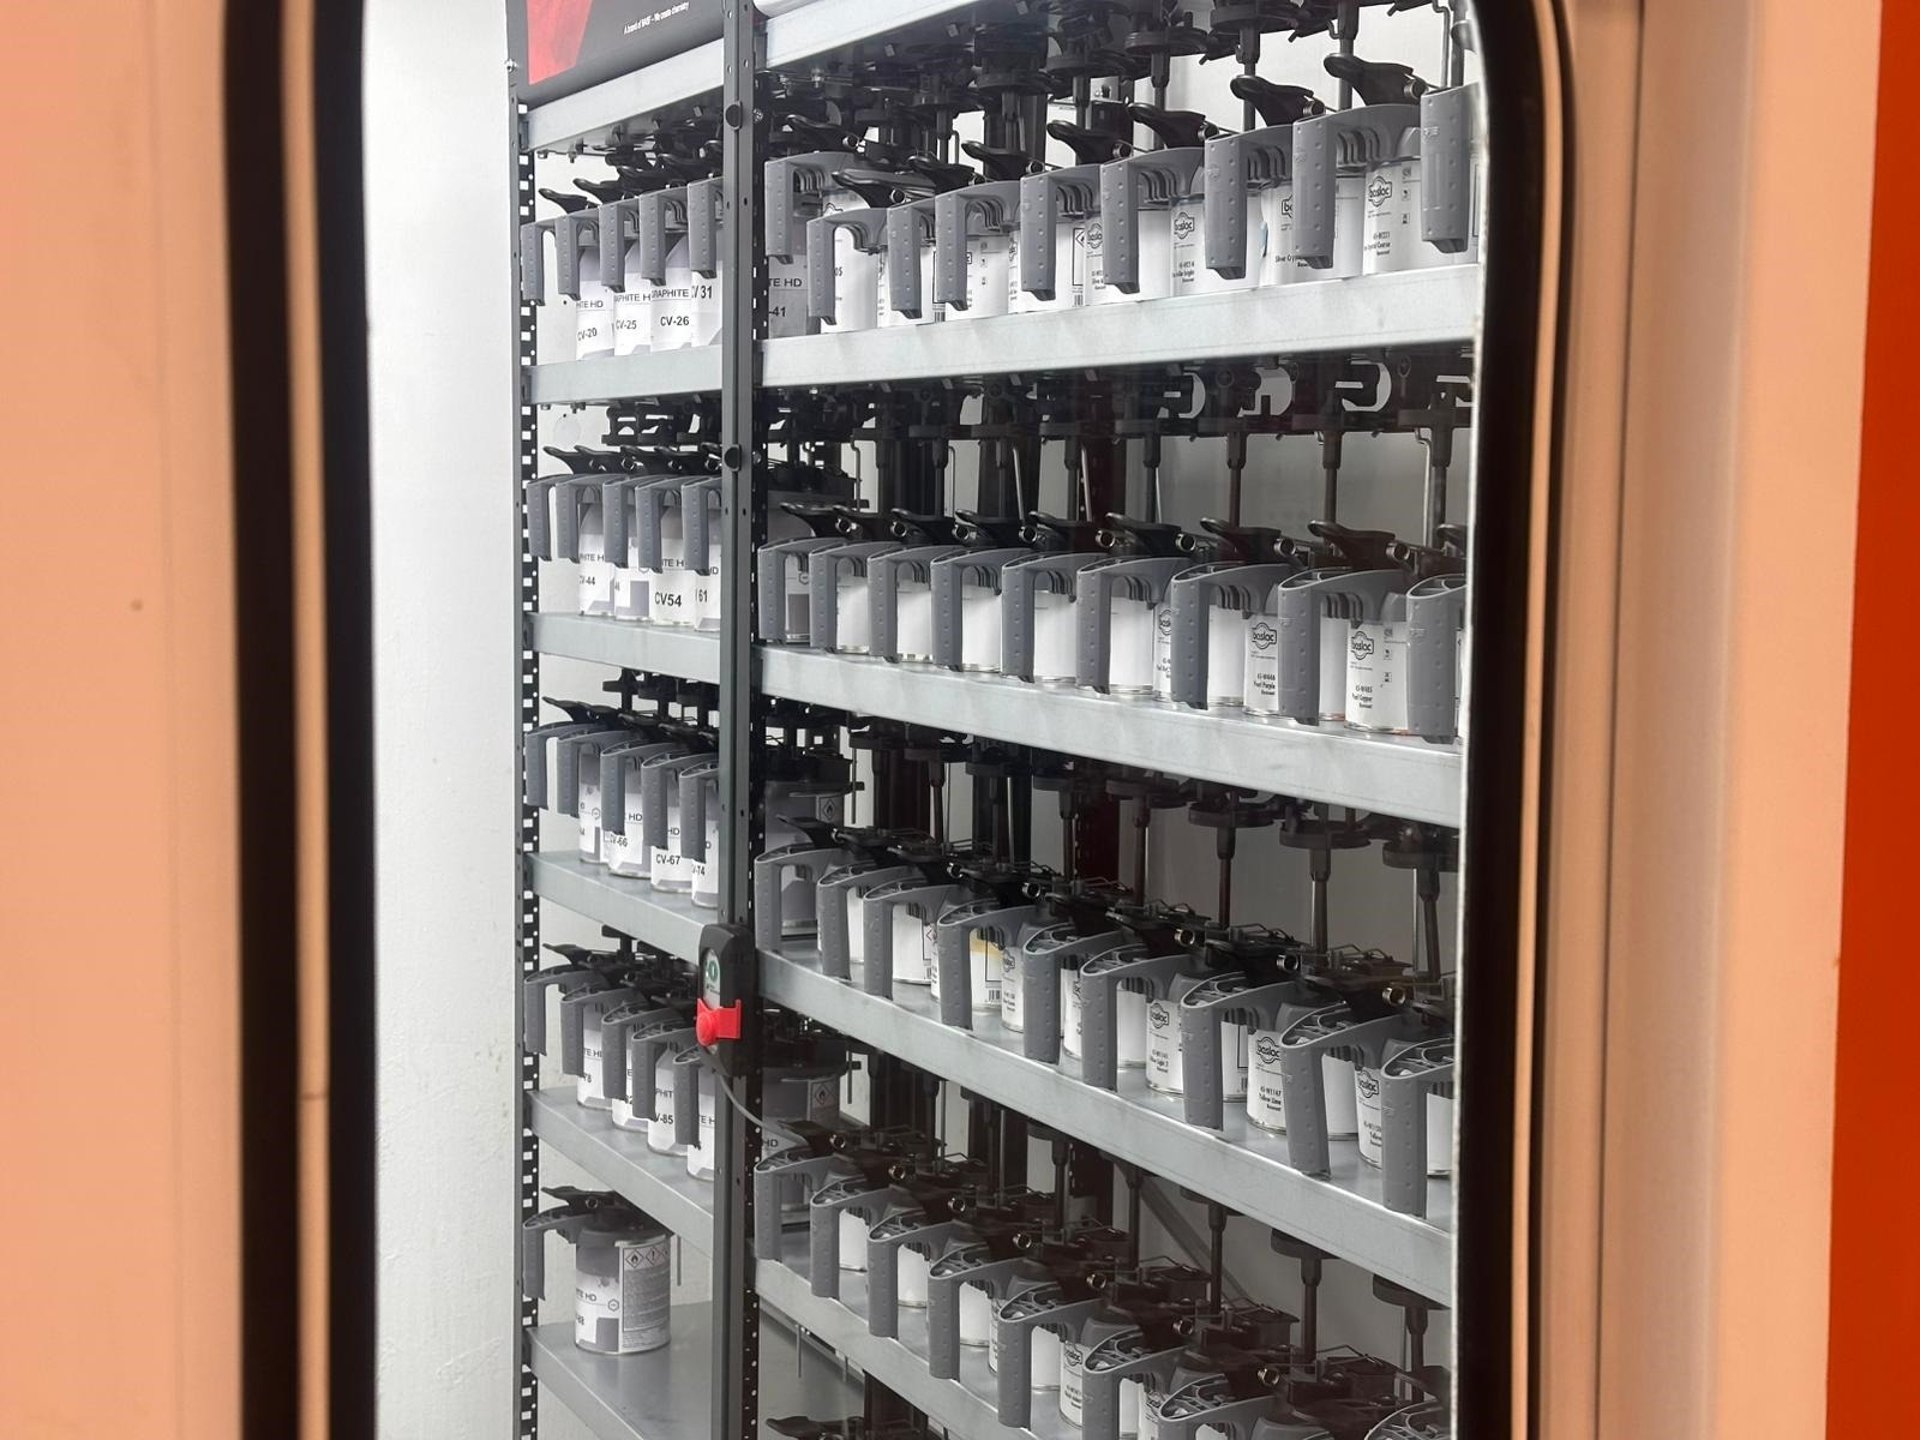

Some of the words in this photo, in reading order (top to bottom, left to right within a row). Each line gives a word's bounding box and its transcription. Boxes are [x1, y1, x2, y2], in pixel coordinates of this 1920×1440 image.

[784, 278, 802, 288] HD
[700, 285, 712, 300] 31
[660, 315, 690, 327] CV-26
[654, 591, 683, 608] CV54
[628, 812, 643, 822] HD
[655, 853, 681, 866] CV-67
